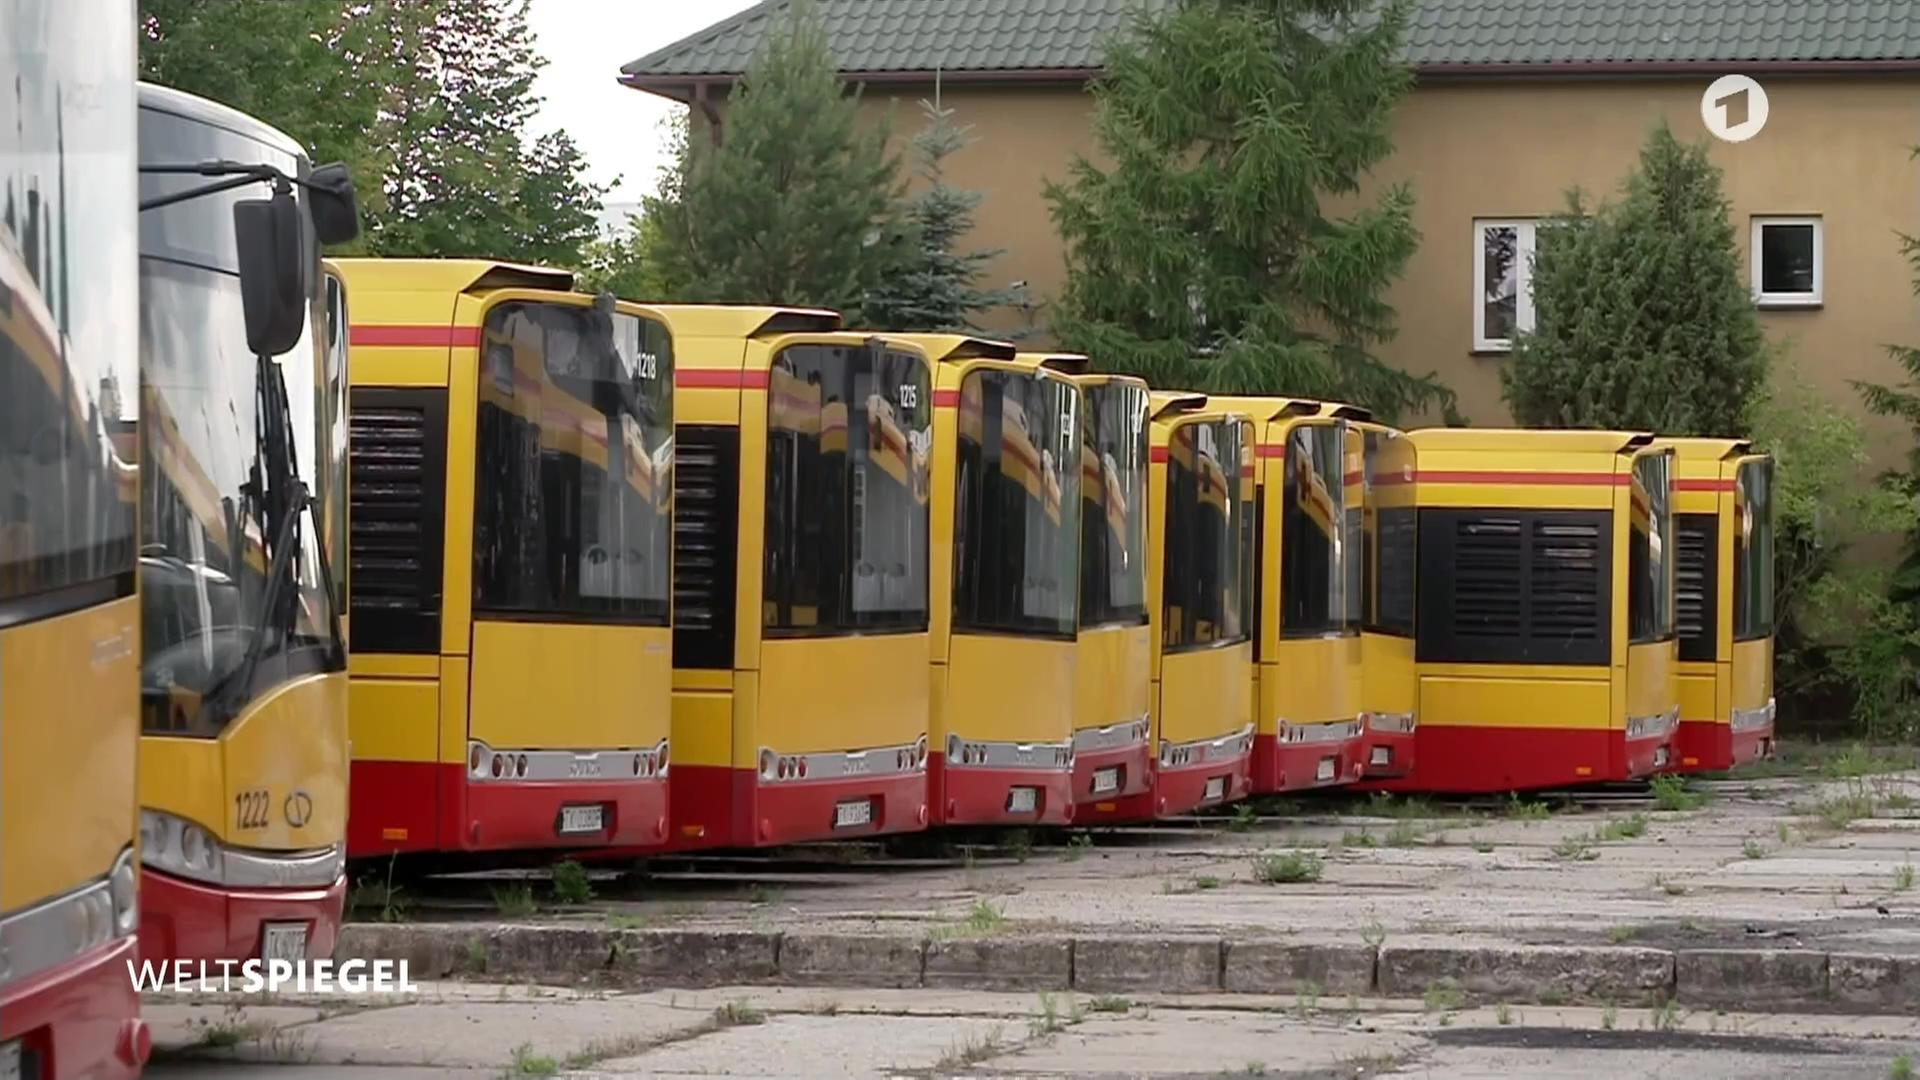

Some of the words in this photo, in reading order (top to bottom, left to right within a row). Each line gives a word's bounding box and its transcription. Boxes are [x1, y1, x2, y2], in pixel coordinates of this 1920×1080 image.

[637, 353, 657, 380] 1218
[899, 385, 917, 409] 1215
[235, 790, 269, 830] 1222
